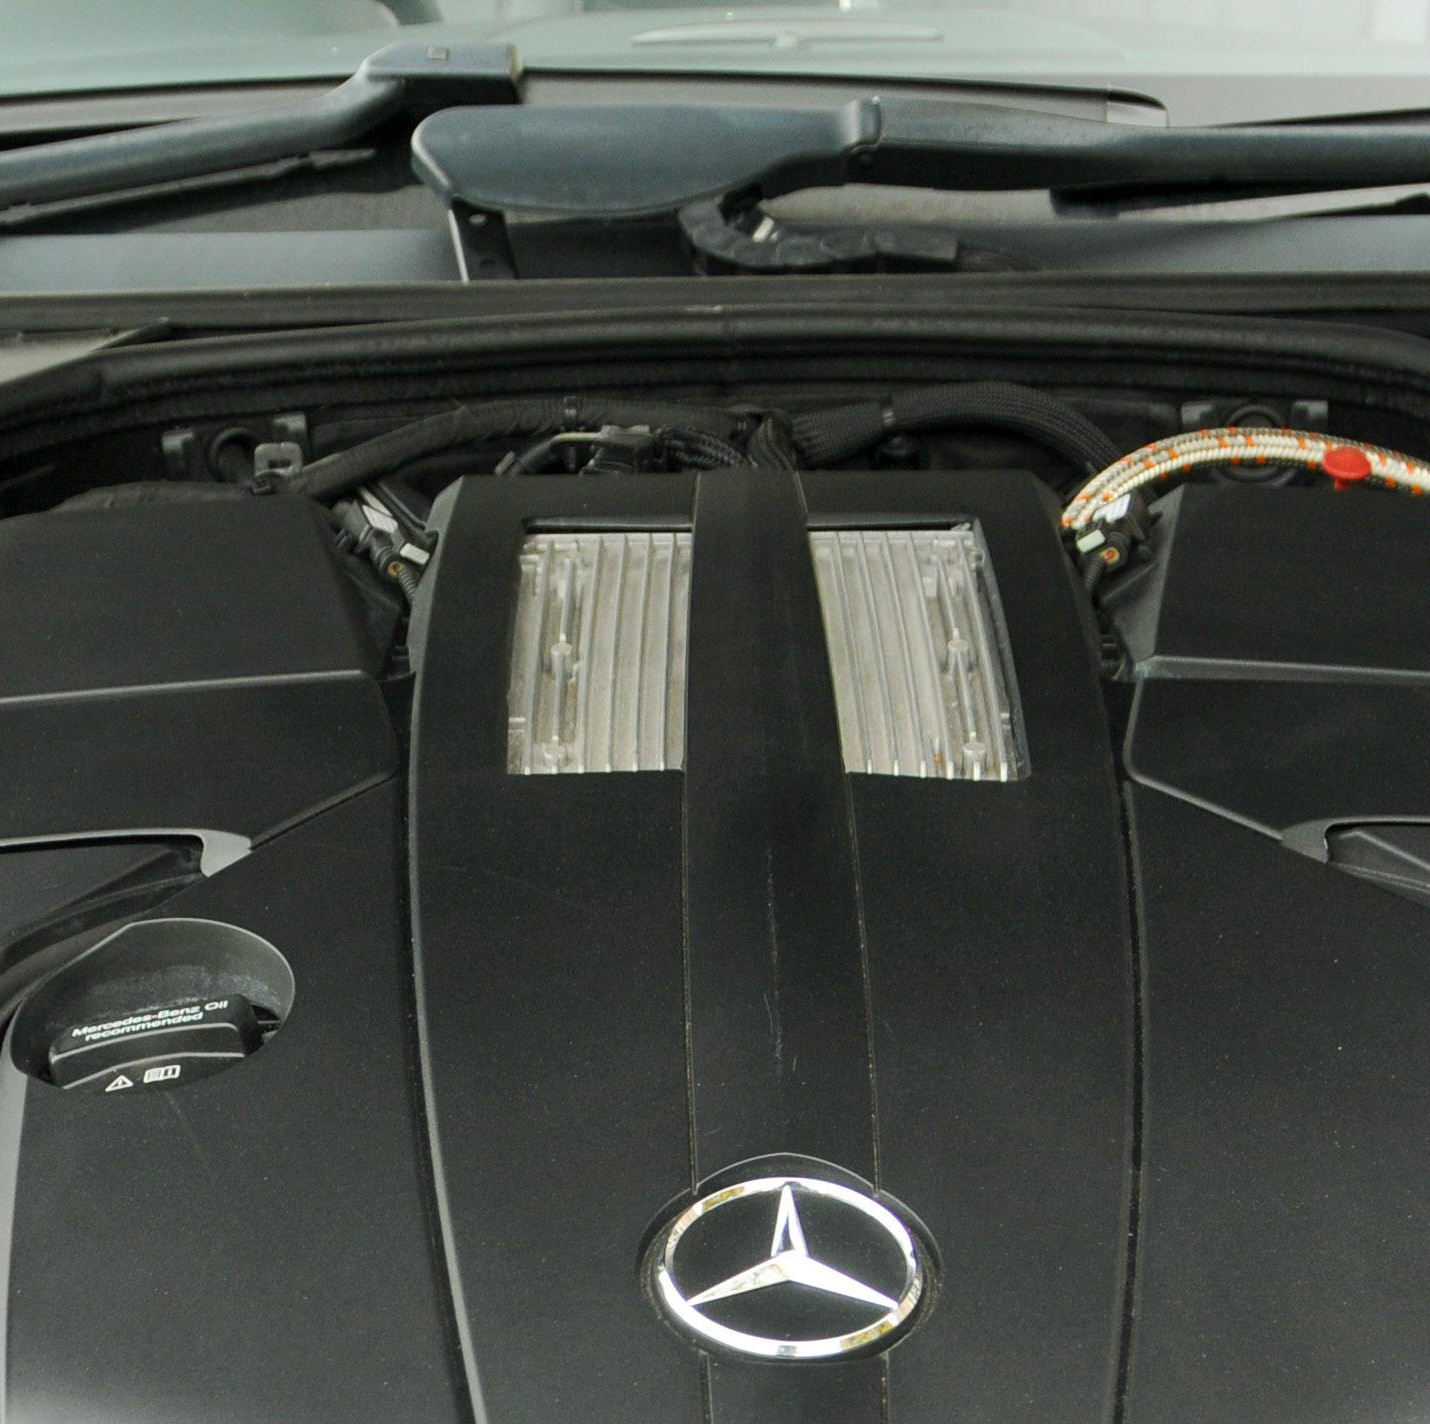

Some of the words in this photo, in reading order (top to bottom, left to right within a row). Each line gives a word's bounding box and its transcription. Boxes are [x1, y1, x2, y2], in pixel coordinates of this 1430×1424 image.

[72, 1005, 201, 1037] Mercedes-Benz
[204, 1000, 229, 1011] Oil
[84, 1012, 204, 1042] recommended
